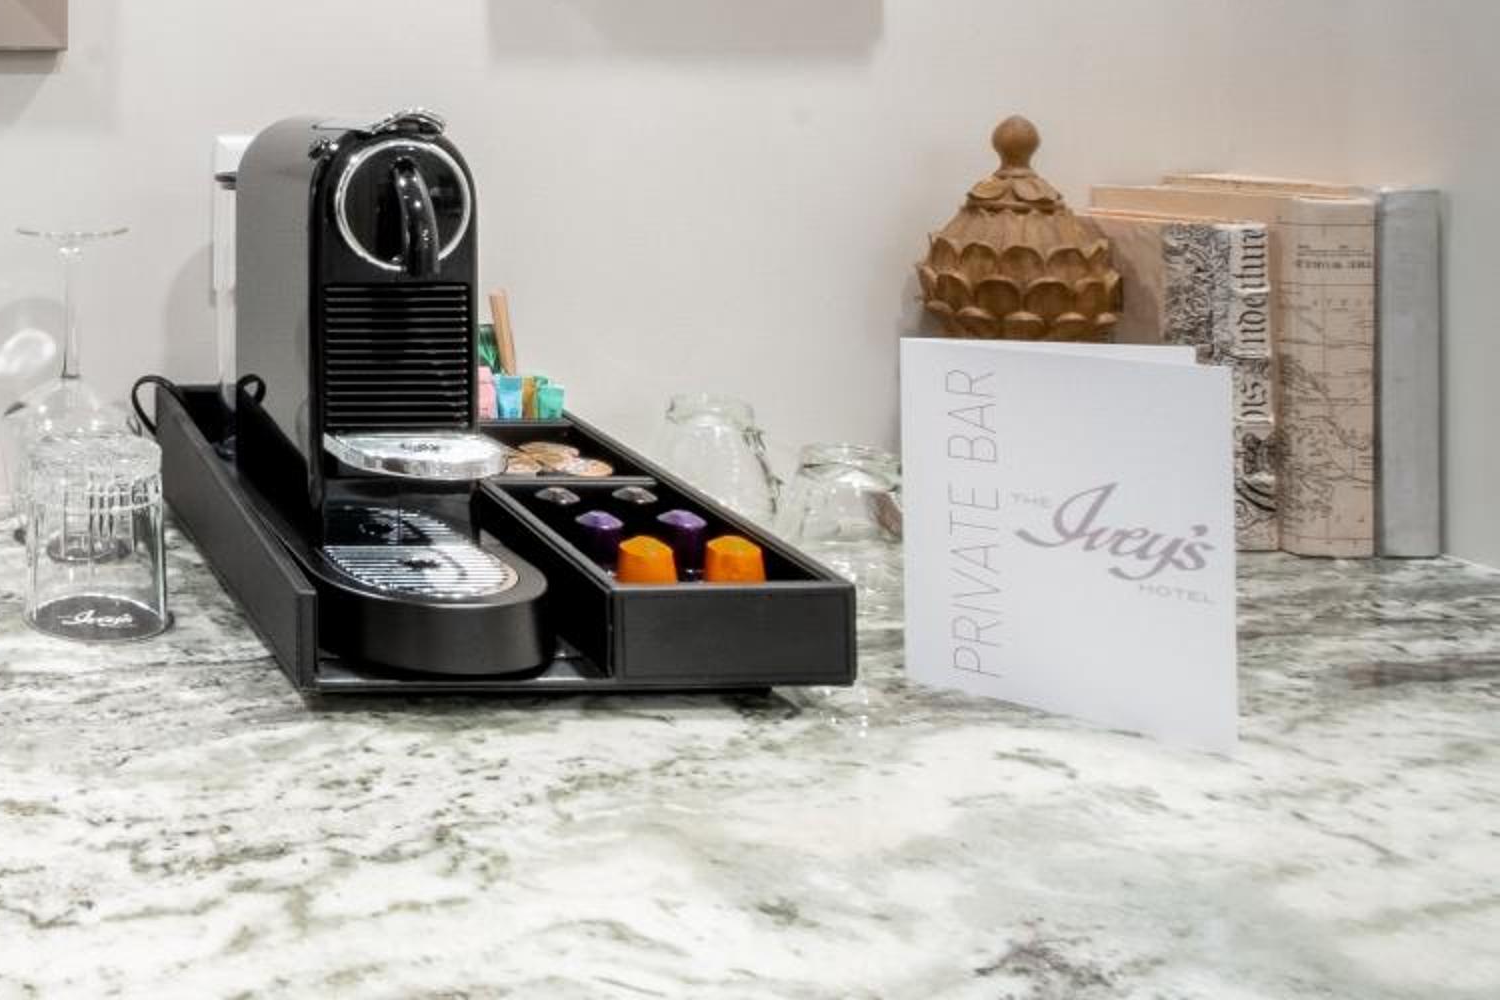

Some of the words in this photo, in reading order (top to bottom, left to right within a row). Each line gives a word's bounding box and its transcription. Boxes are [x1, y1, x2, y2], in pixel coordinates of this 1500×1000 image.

[945, 369, 998, 463] BAR
[1011, 491, 1051, 508] THE
[1015, 481, 1216, 582] Ivey's
[948, 481, 1003, 679] PRIVATE
[1138, 583, 1215, 604] HOTEL
